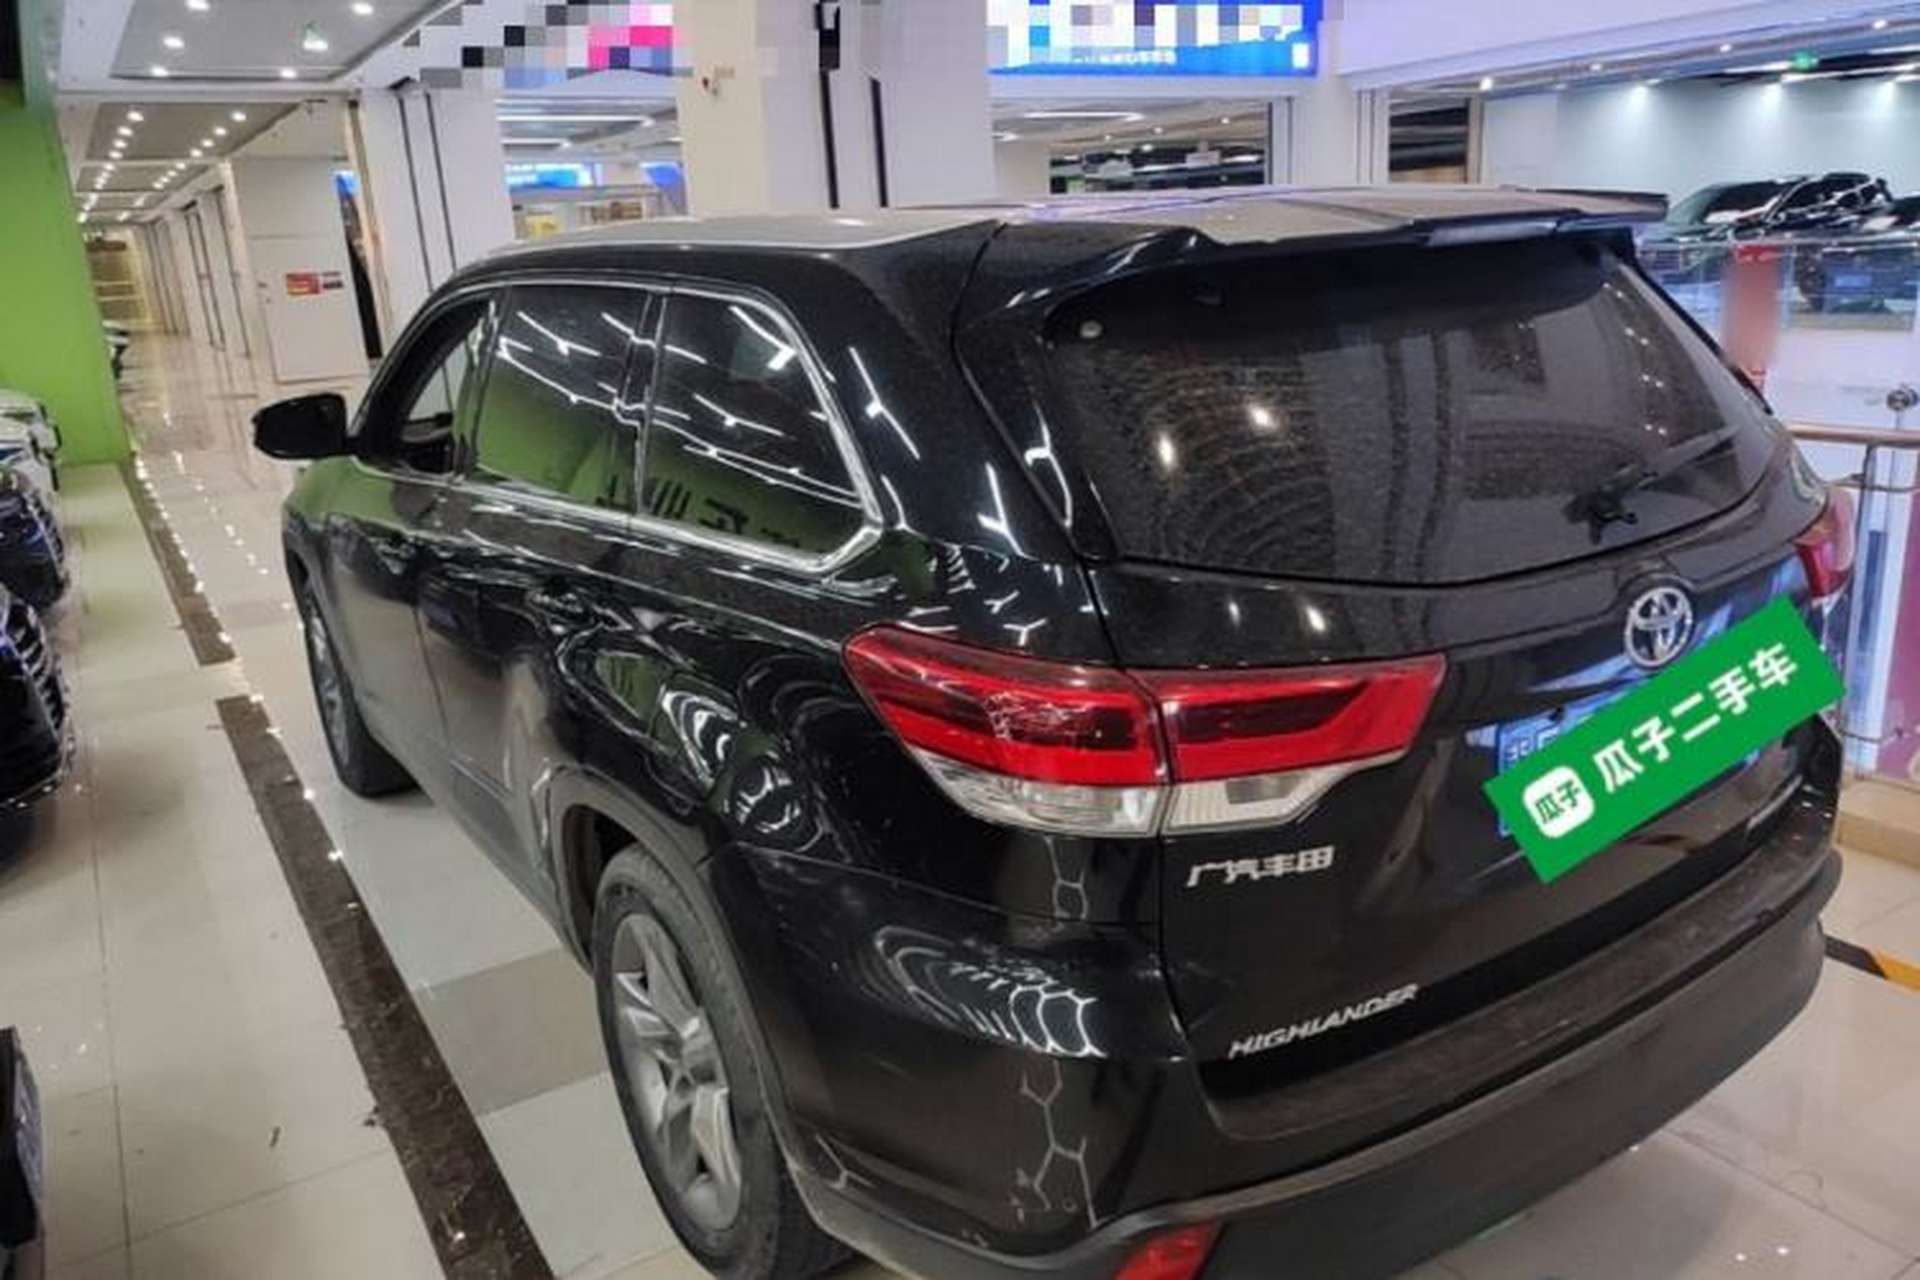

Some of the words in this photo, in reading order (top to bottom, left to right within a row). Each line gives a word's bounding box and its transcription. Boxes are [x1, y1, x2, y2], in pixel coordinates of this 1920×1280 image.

[1186, 845, 1335, 888] 广汽丰田
[1228, 983, 1419, 1060] HIGHLANDER
